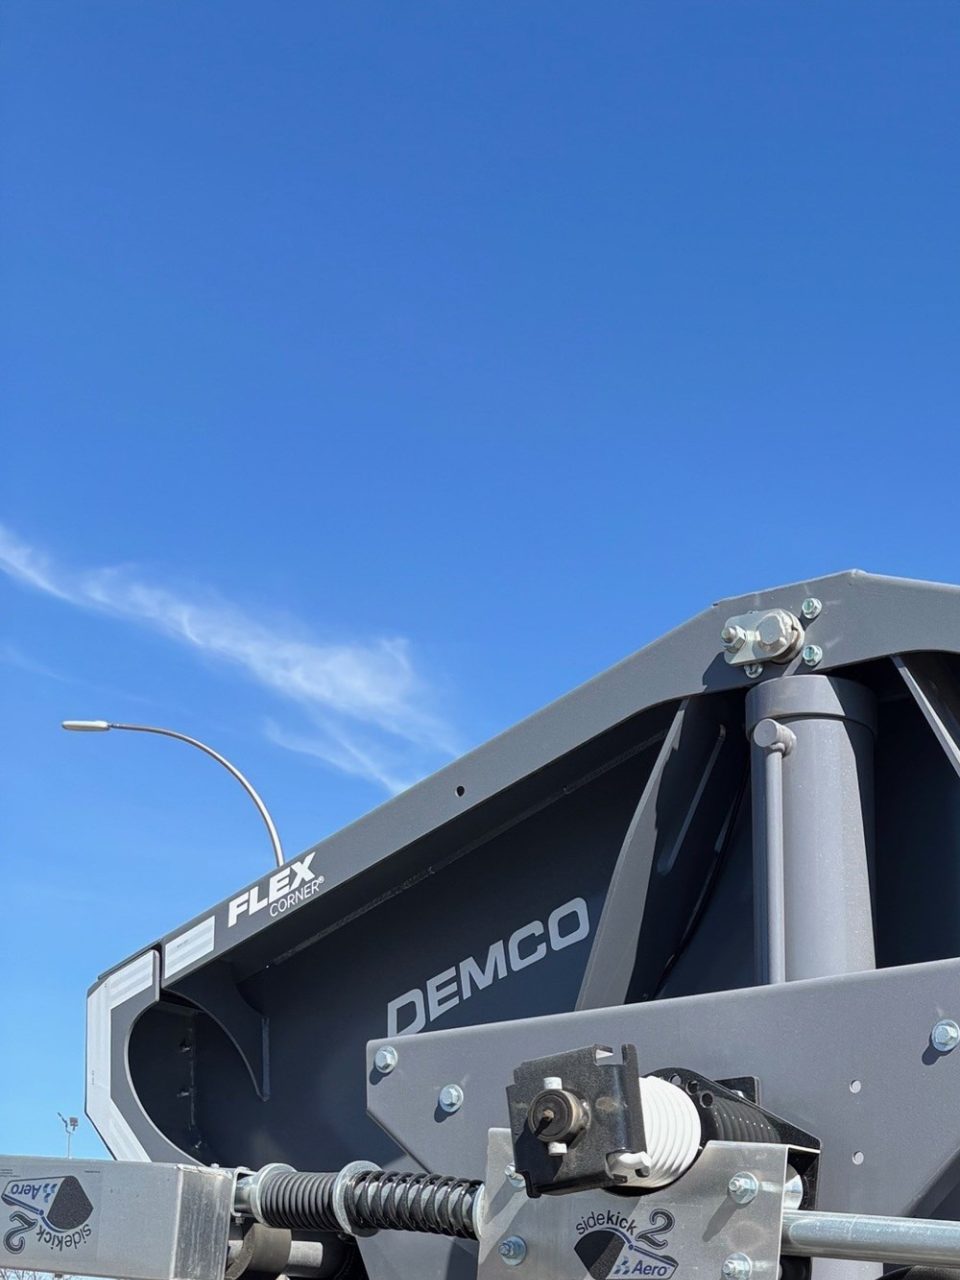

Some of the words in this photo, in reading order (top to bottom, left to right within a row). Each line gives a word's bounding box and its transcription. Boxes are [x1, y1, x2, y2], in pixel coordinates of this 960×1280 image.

[227, 852, 317, 928] FLEX
[385, 896, 591, 1038] DEMCO
[10, 1183, 42, 1200] Aero
[4, 1210, 39, 1254] 2
[35, 1223, 92, 1252] sidekick
[575, 1209, 638, 1236] sidekick
[635, 1207, 676, 1250] 2
[631, 1259, 669, 1277] Aero
